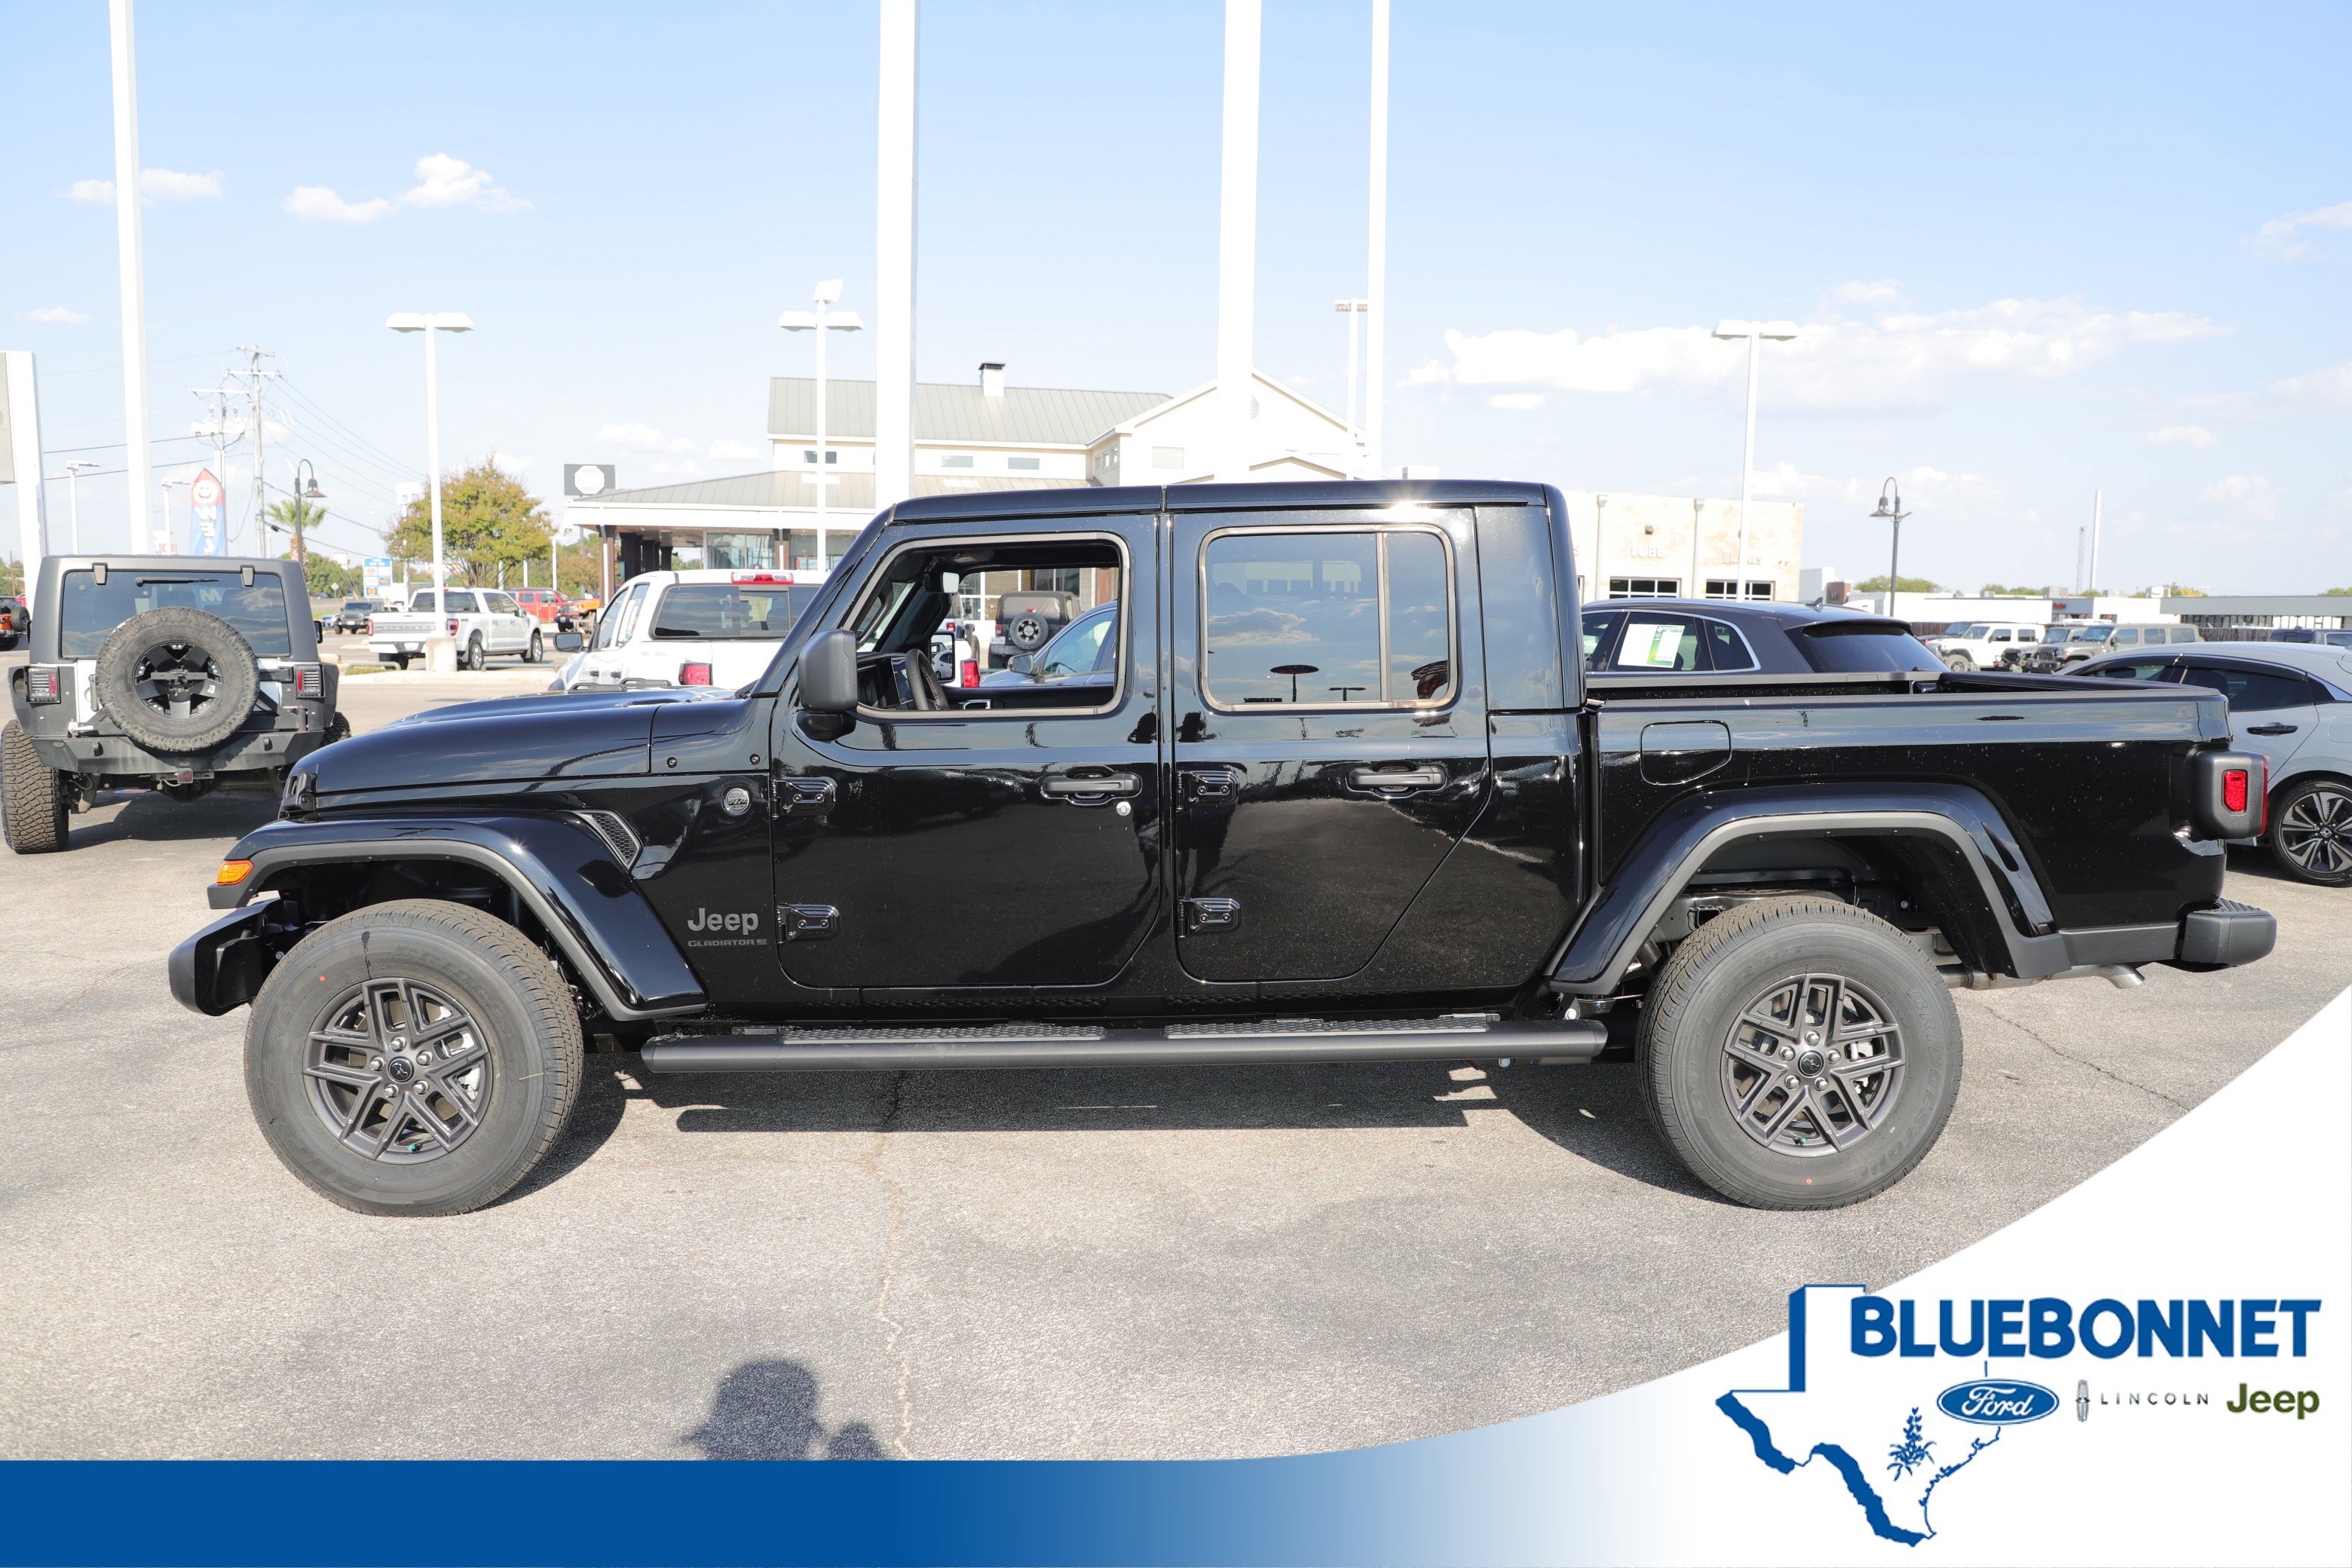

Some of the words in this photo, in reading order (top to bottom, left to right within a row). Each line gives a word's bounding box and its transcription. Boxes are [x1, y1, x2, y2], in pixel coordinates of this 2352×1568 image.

[1631, 545, 1664, 559] LUBE
[1723, 553, 1762, 565] BRKES
[687, 907, 759, 936] Jeep
[688, 939, 756, 947] GLADIATOR
